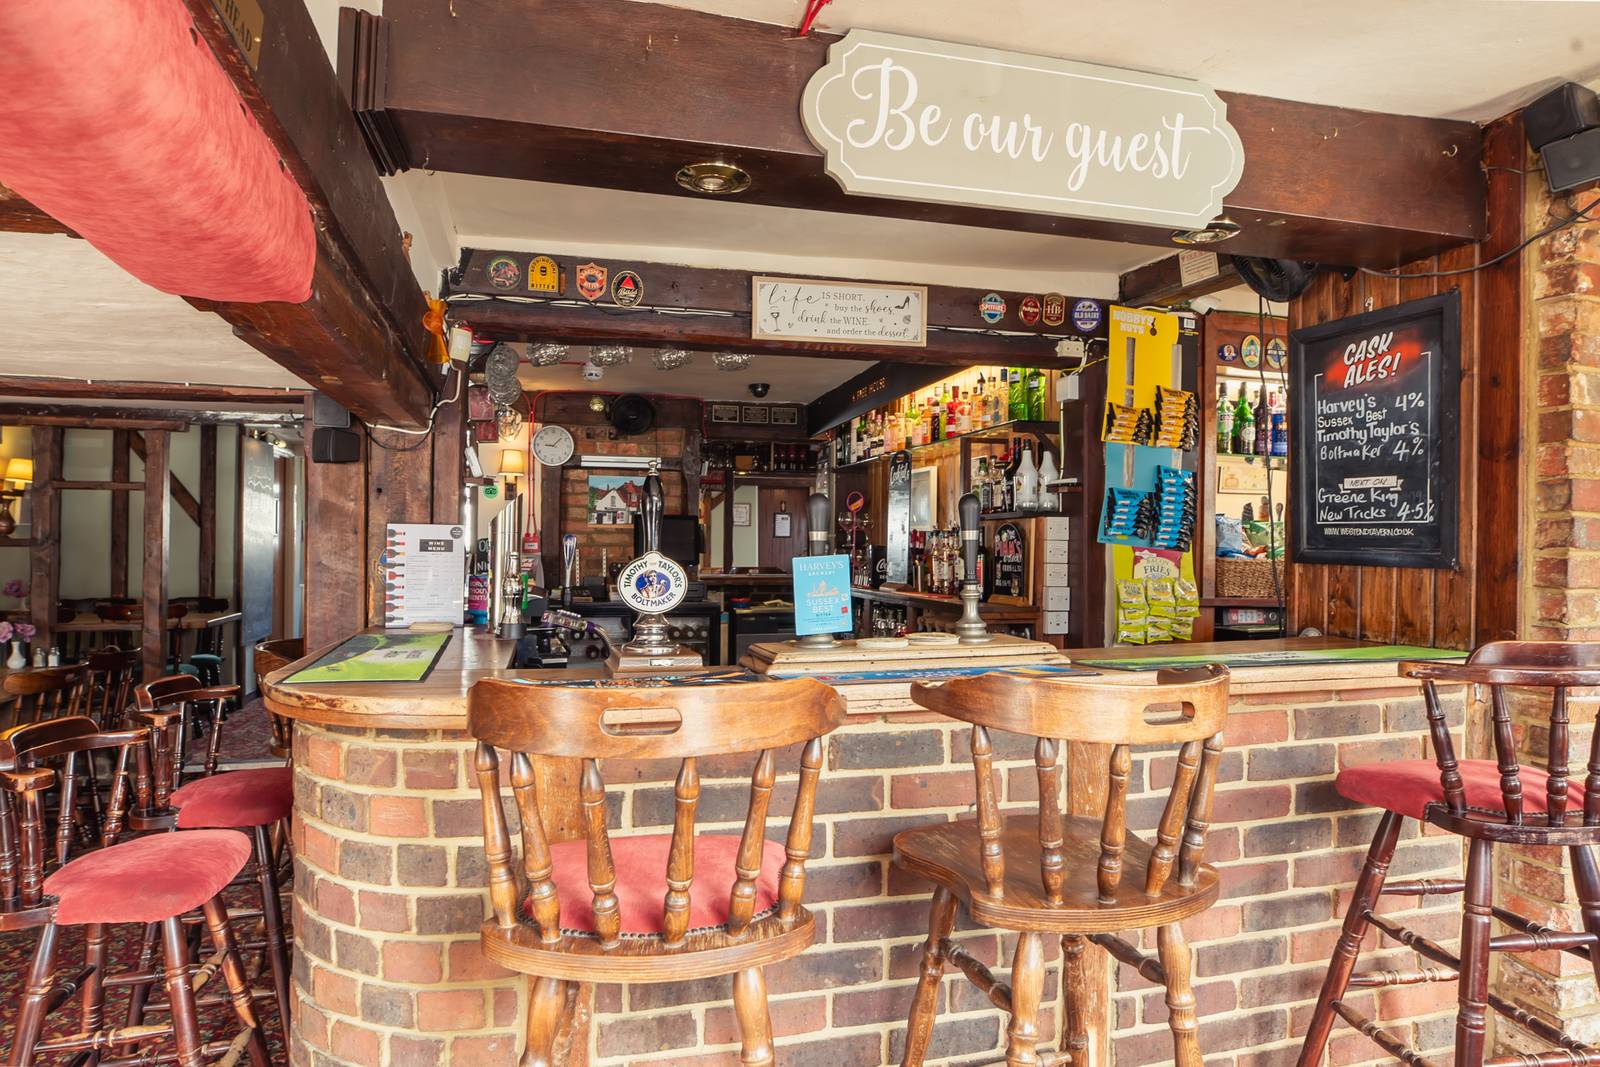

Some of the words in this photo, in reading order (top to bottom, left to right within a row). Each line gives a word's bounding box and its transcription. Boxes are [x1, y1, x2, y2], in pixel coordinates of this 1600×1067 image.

[847, 58, 951, 151] Be
[963, 113, 1053, 162] our
[1065, 113, 1211, 191] guest
[769, 284, 822, 314] life
[822, 291, 831, 300] IS
[834, 303, 848, 312] buy
[850, 304, 863, 312] the
[798, 310, 826, 324] drink
[830, 316, 842, 324] the
[842, 328, 863, 336] order
[1120, 322, 1144, 334] NUTS
[1343, 331, 1394, 366] CASK
[1343, 352, 1401, 389] ALES!
[1318, 394, 1377, 418] Harvey's
[1395, 392, 1425, 411] 4%
[1317, 416, 1353, 428] Sussex
[1366, 408, 1388, 422] Best
[1317, 427, 1367, 445] Timothy
[1366, 421, 1419, 441] Taylor's
[1393, 437, 1424, 461] 4%
[1318, 488, 1367, 504] Greene
[1370, 487, 1398, 507] King
[1320, 506, 1343, 521] New
[1344, 505, 1386, 519] Tricks
[624, 560, 648, 588] TIMOTHY
[658, 560, 683, 589] TAYLOR'S
[800, 561, 844, 571] HARVEY'S
[1144, 565, 1170, 577] FRIES
[631, 592, 676, 607] BOLTMAKER
[812, 605, 832, 613] BEST
